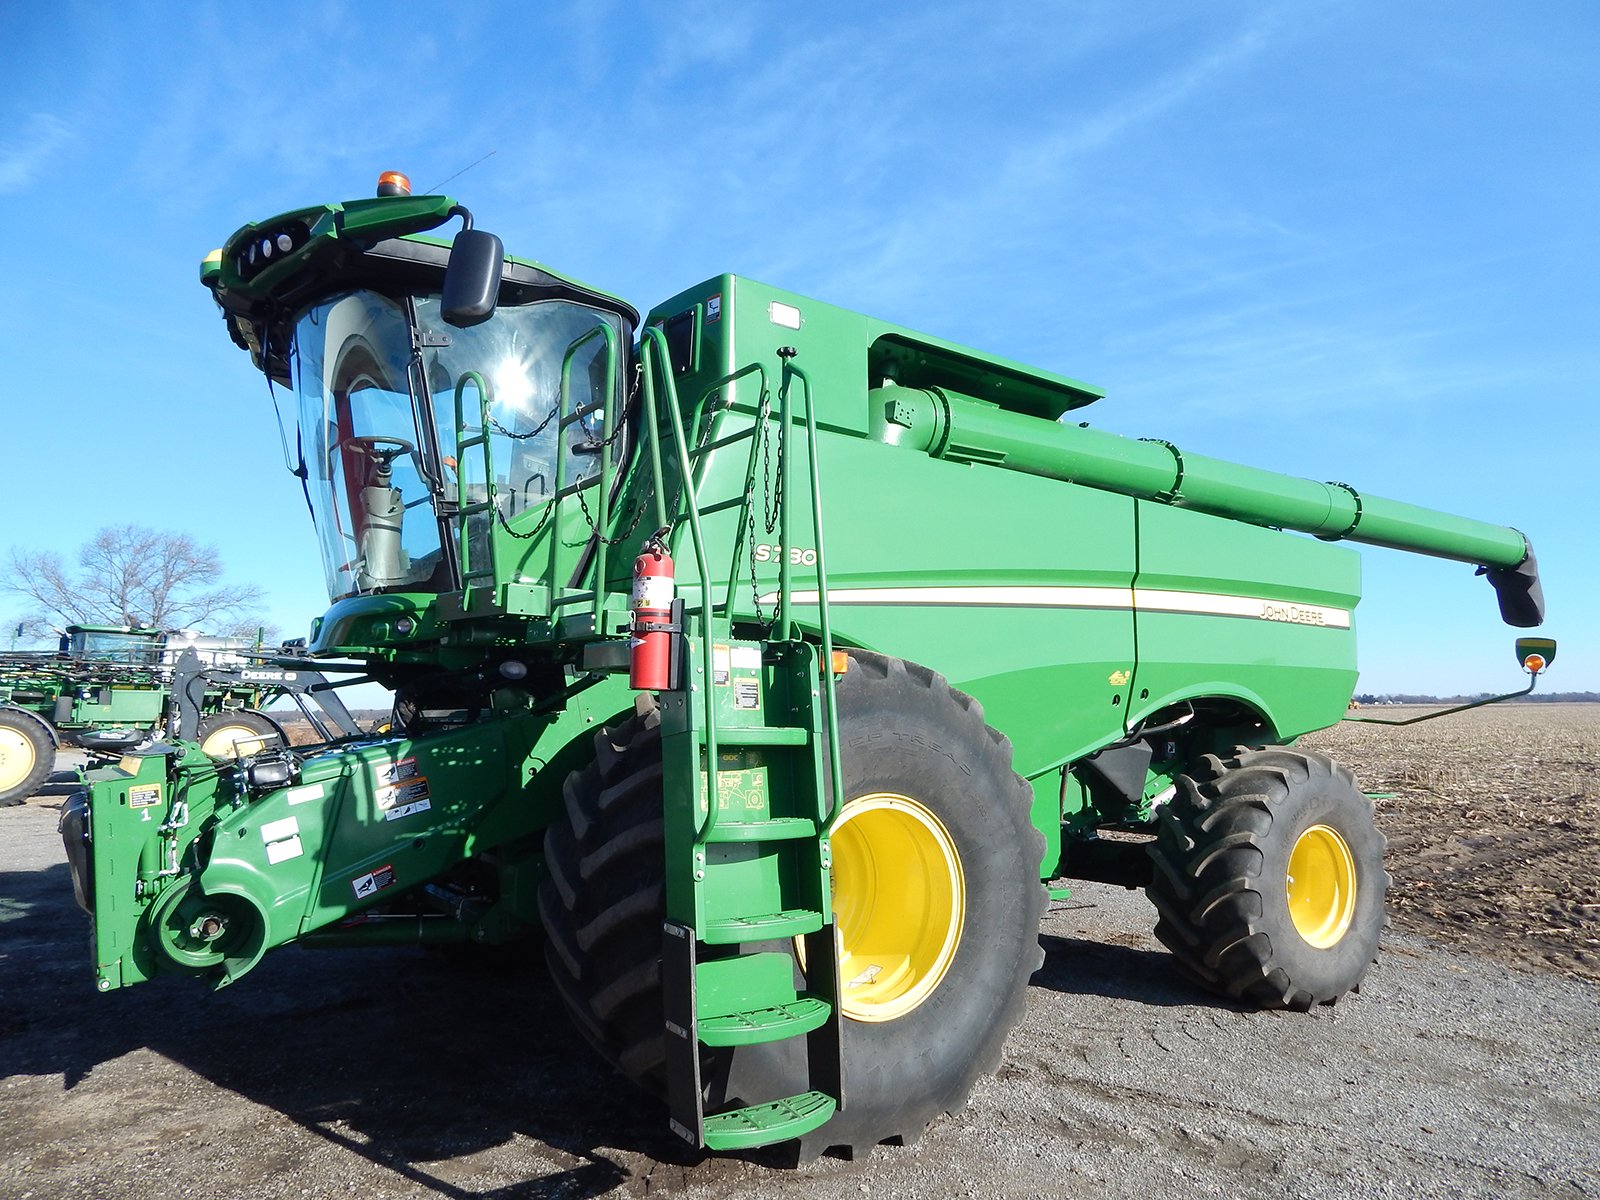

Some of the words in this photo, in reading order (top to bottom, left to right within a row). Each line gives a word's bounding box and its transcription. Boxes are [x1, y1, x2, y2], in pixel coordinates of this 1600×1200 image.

[1260, 602, 1289, 619] JOHN
[1290, 606, 1324, 624] DEERE
[241, 670, 283, 681] DEERE
[140, 807, 152, 822] 1
